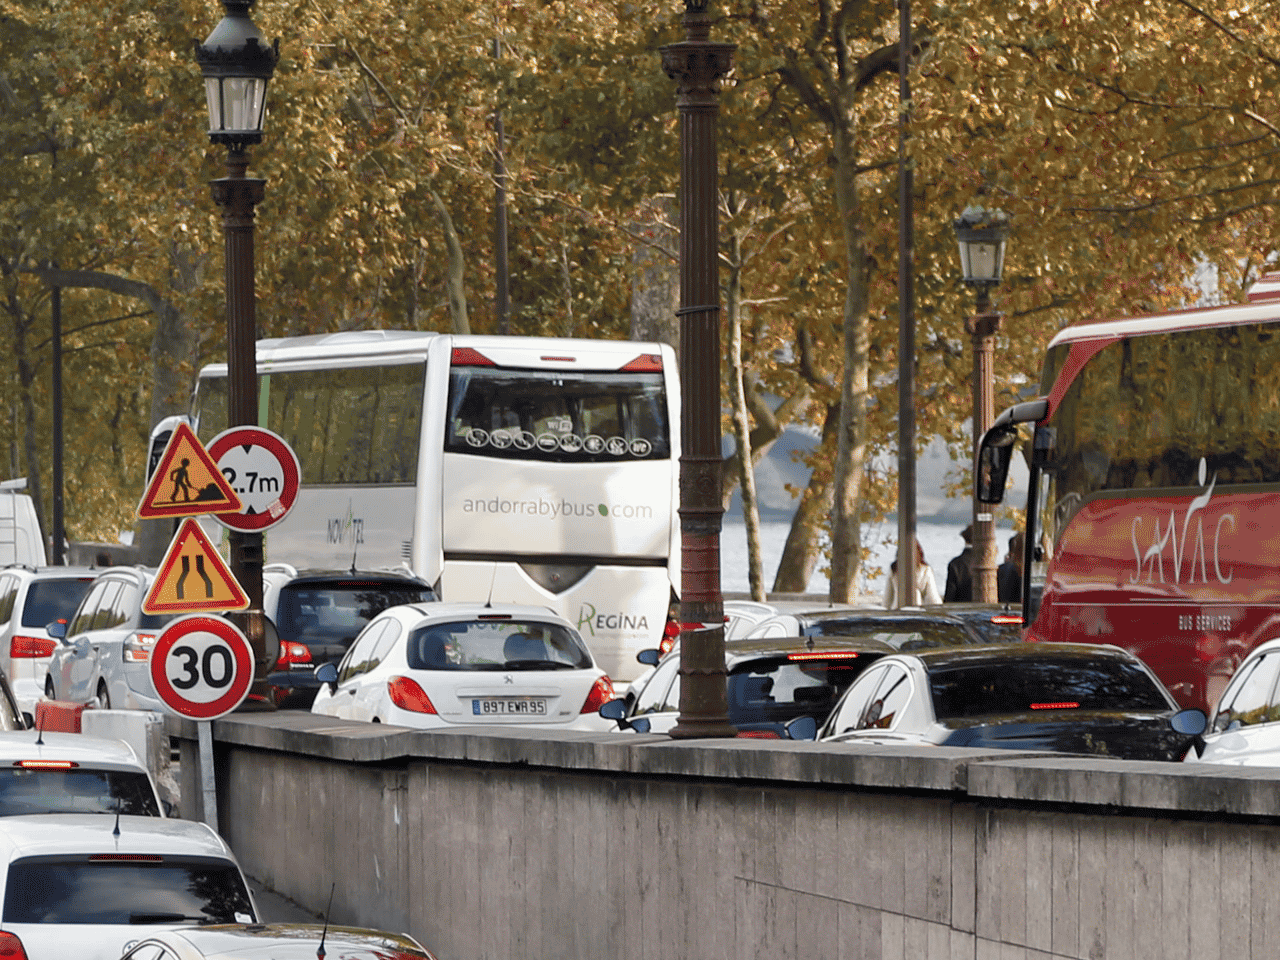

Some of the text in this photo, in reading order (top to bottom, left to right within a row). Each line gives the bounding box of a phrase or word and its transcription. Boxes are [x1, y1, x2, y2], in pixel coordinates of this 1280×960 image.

[1179, 614, 1231, 631] BUS SERVICES
[171, 644, 234, 690] 30
[483, 701, 505, 713] 897
[530, 701, 545, 713] 95
